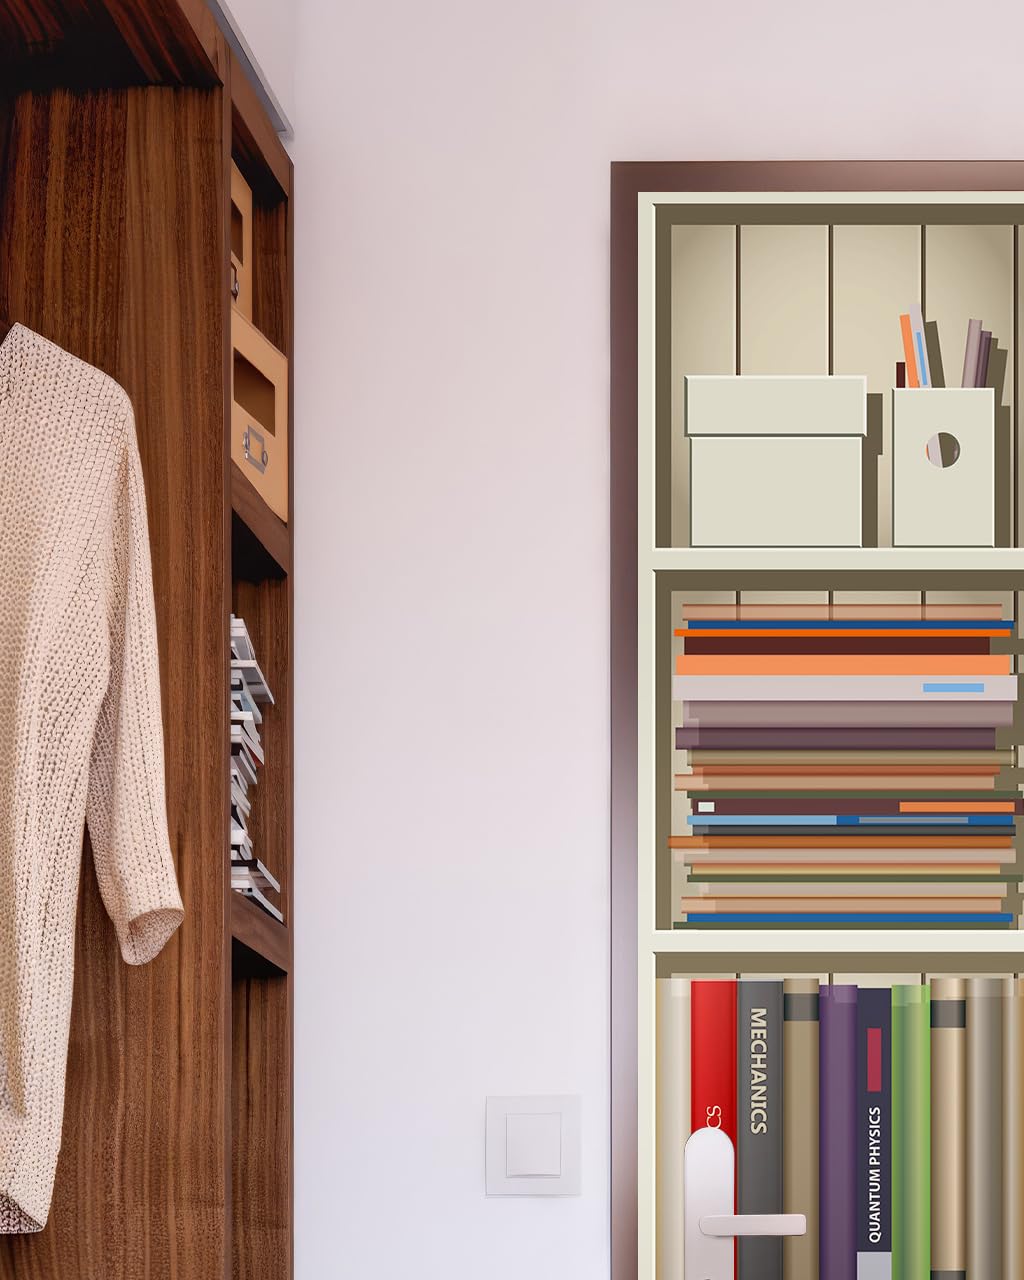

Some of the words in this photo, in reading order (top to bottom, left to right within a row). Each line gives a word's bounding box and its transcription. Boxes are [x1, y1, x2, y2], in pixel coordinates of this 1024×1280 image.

[750, 1007, 768, 1135] MECHANICS
[868, 1107, 881, 1166] PHYSICS
[868, 1168, 881, 1243] QUANTUM
